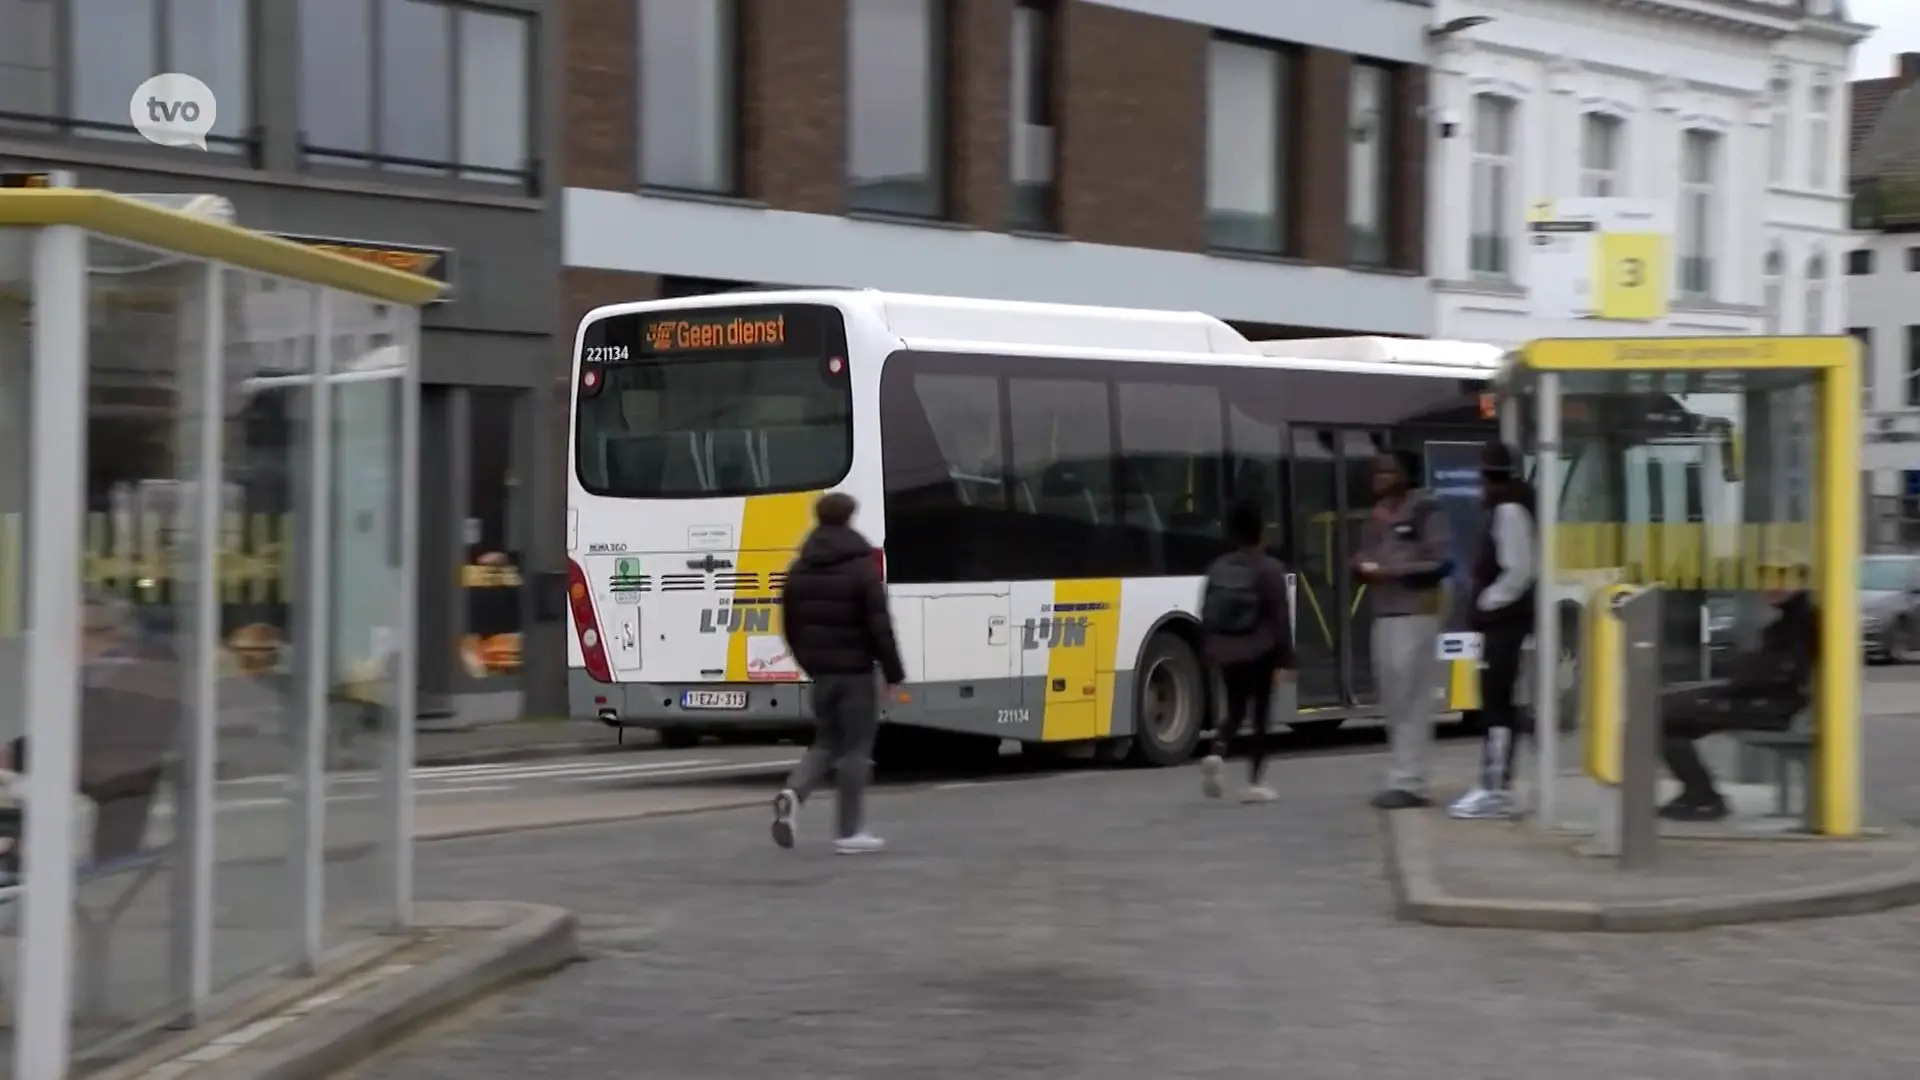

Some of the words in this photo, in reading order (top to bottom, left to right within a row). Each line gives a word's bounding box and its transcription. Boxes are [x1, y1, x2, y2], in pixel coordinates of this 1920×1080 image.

[1618, 257, 1646, 288] 3
[677, 320, 724, 348] Geen
[727, 314, 785, 345] dienst
[586, 345, 629, 361] 221134
[997, 709, 1029, 723] 221134
